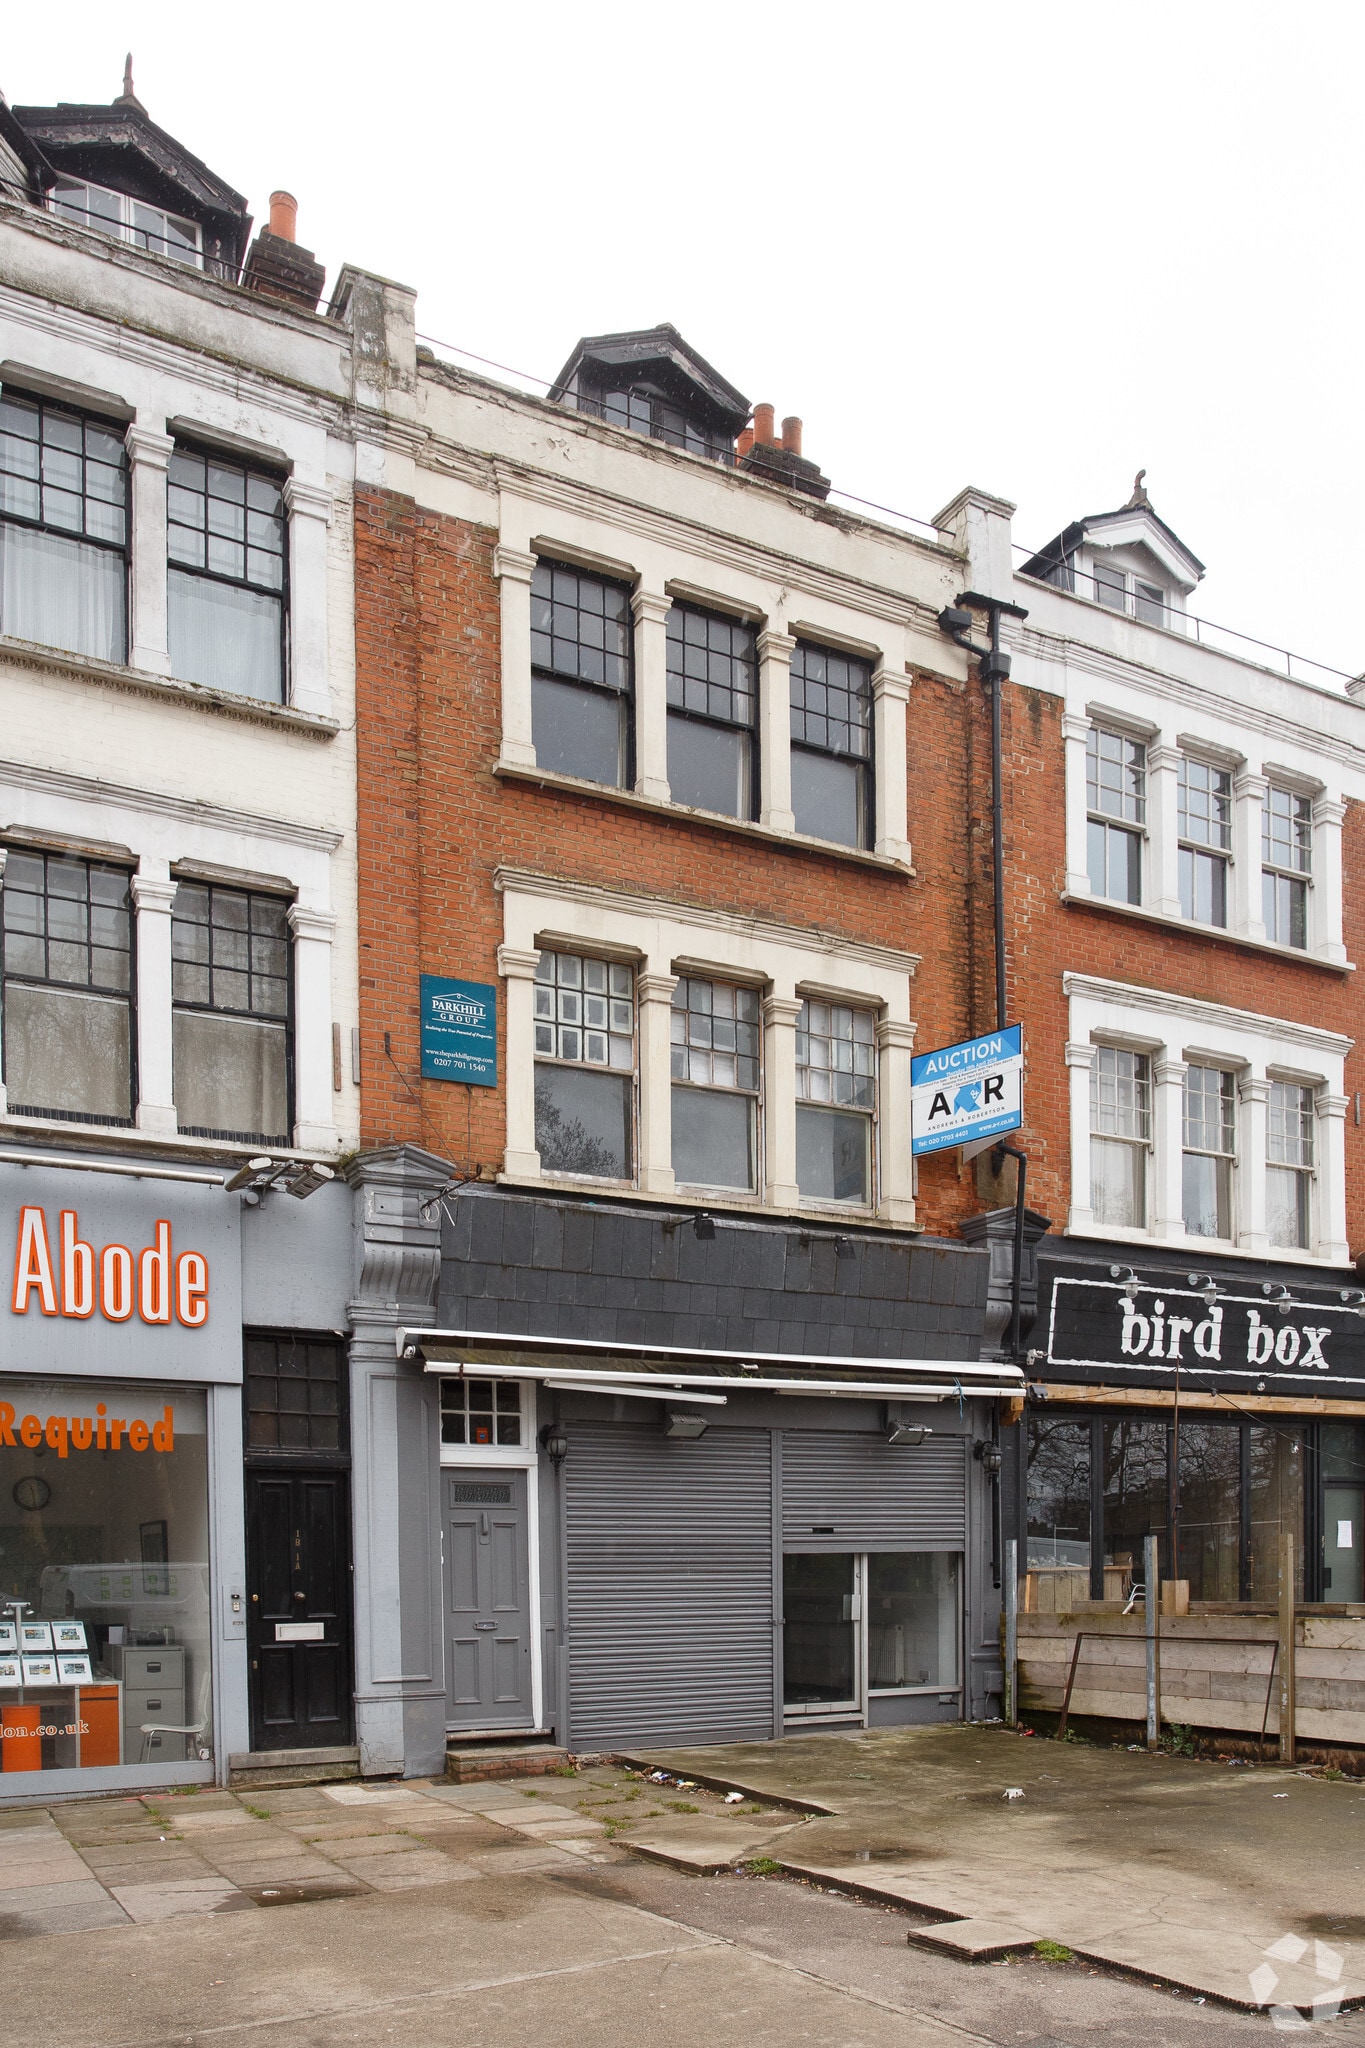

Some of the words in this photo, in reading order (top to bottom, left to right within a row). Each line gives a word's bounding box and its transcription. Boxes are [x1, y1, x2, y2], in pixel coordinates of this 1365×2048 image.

[432, 1000, 486, 1016] PARKHILL
[440, 1013, 478, 1025] GROUP
[425, 1049, 494, 1064] www.theparkhillgroup.com
[433, 1057, 451, 1067] 0207
[453, 1060, 466, 1069] 701
[469, 1063, 486, 1072] 1540
[926, 1038, 1002, 1075] AUCTION
[928, 1092, 951, 1120] A
[984, 1074, 1004, 1104] R
[928, 1121, 958, 1131] ANDREWS
[968, 1106, 1006, 1120] ROBERTSON
[928, 1137, 939, 1145] 020
[940, 1134, 954, 1142] 7703
[954, 1130, 969, 1138] 4401
[12, 1206, 209, 1328] Abode
[1118, 1298, 1223, 1361] bird
[1247, 1310, 1332, 1369] box
[0, 1402, 174, 1459] Required
